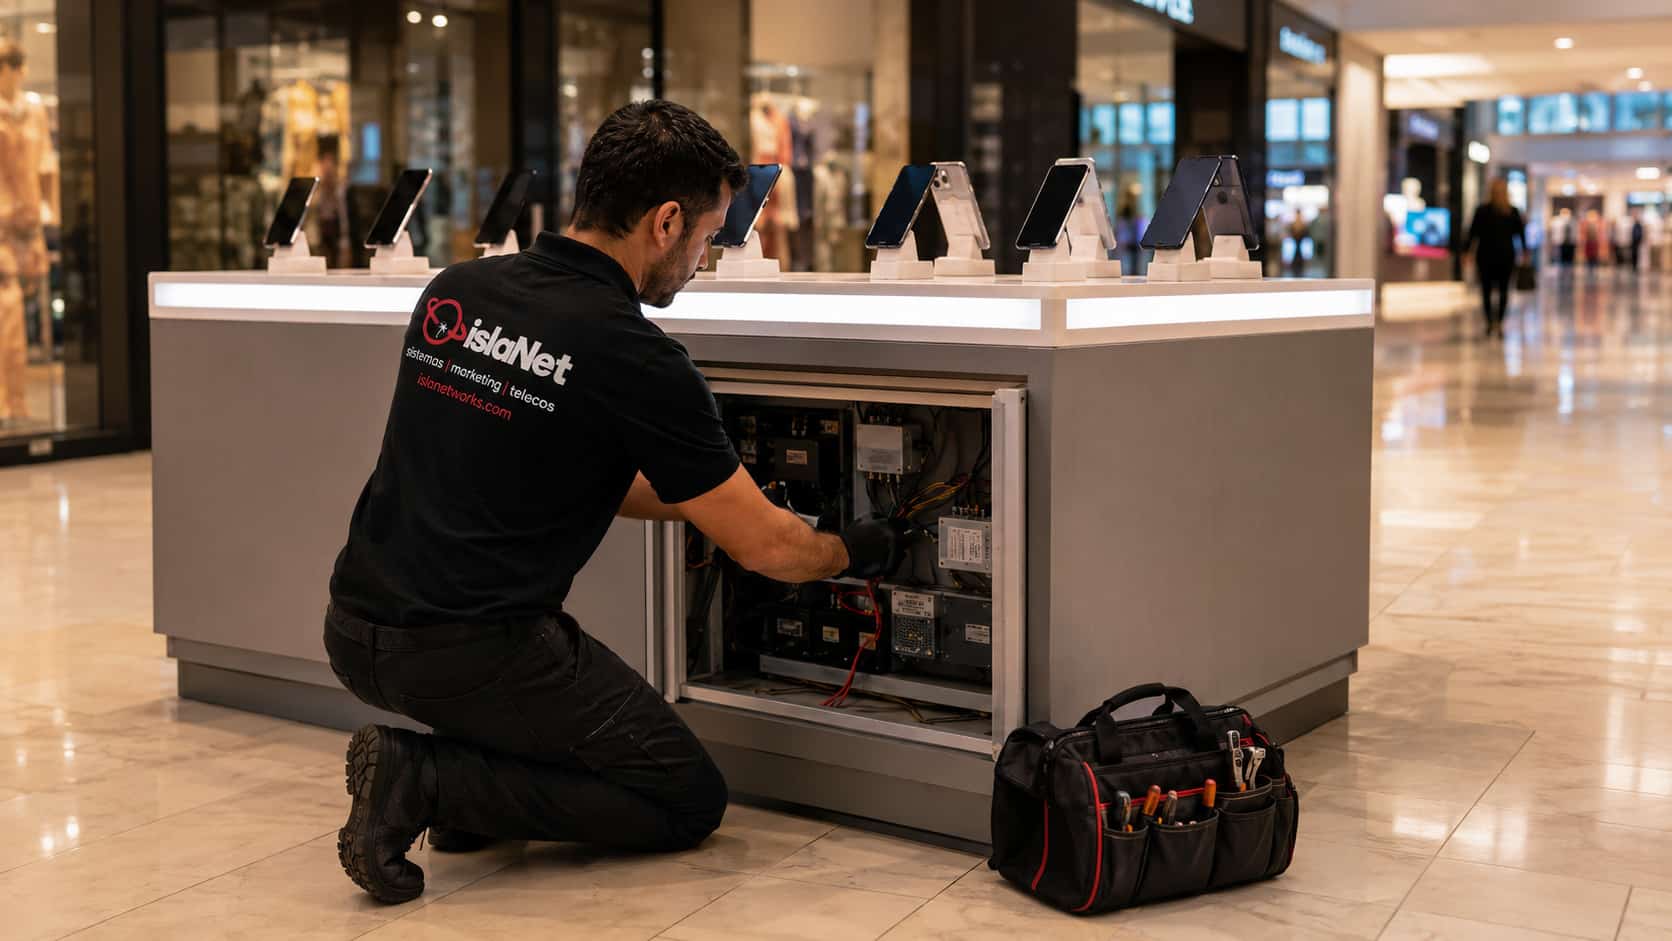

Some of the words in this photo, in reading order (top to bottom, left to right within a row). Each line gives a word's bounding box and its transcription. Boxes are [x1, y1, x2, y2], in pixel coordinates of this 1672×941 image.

[406, 346, 444, 369] sistemas
[450, 363, 502, 394] marketing
[509, 385, 555, 413] telecos
[463, 318, 573, 386] islaNet
[416, 372, 512, 421] islanetworks.com
